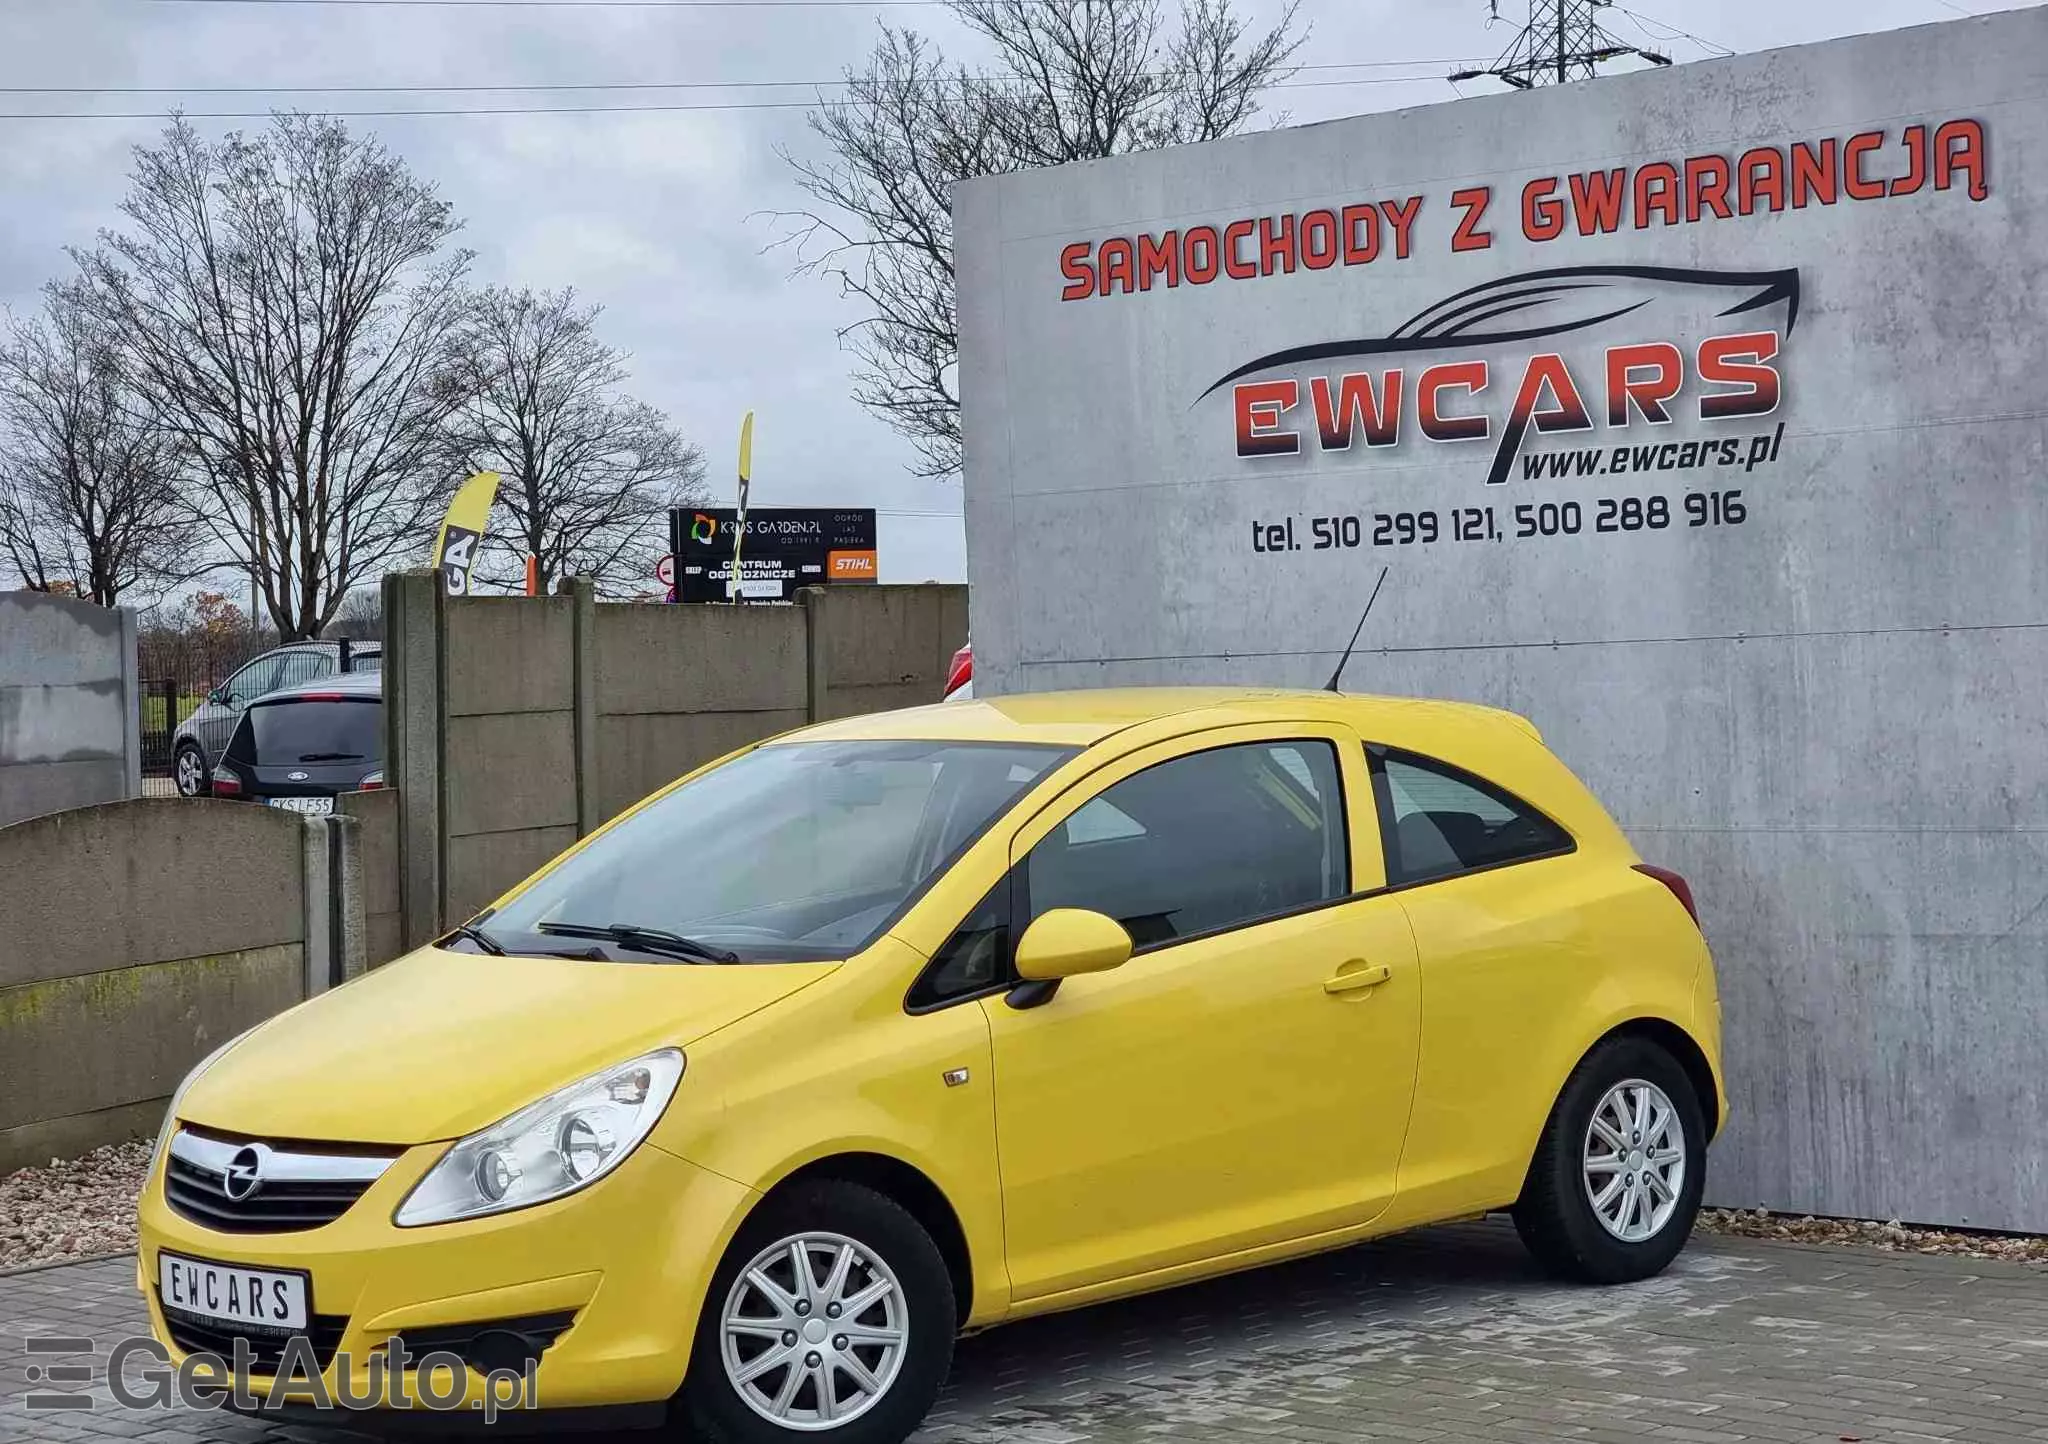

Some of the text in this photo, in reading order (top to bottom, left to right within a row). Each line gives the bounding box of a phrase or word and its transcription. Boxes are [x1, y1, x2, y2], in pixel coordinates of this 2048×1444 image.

[1060, 117, 1989, 302] SAMOCHODY Z GWARANCJĄ
[1232, 329, 1781, 485] EWCARS
[1523, 422, 1786, 482] www.ewcars.pl
[1253, 489, 1747, 554] tel. 510 299 121, 500 288 916
[835, 558, 873, 570] STIHL
[171, 1262, 289, 1320] EWCARS
